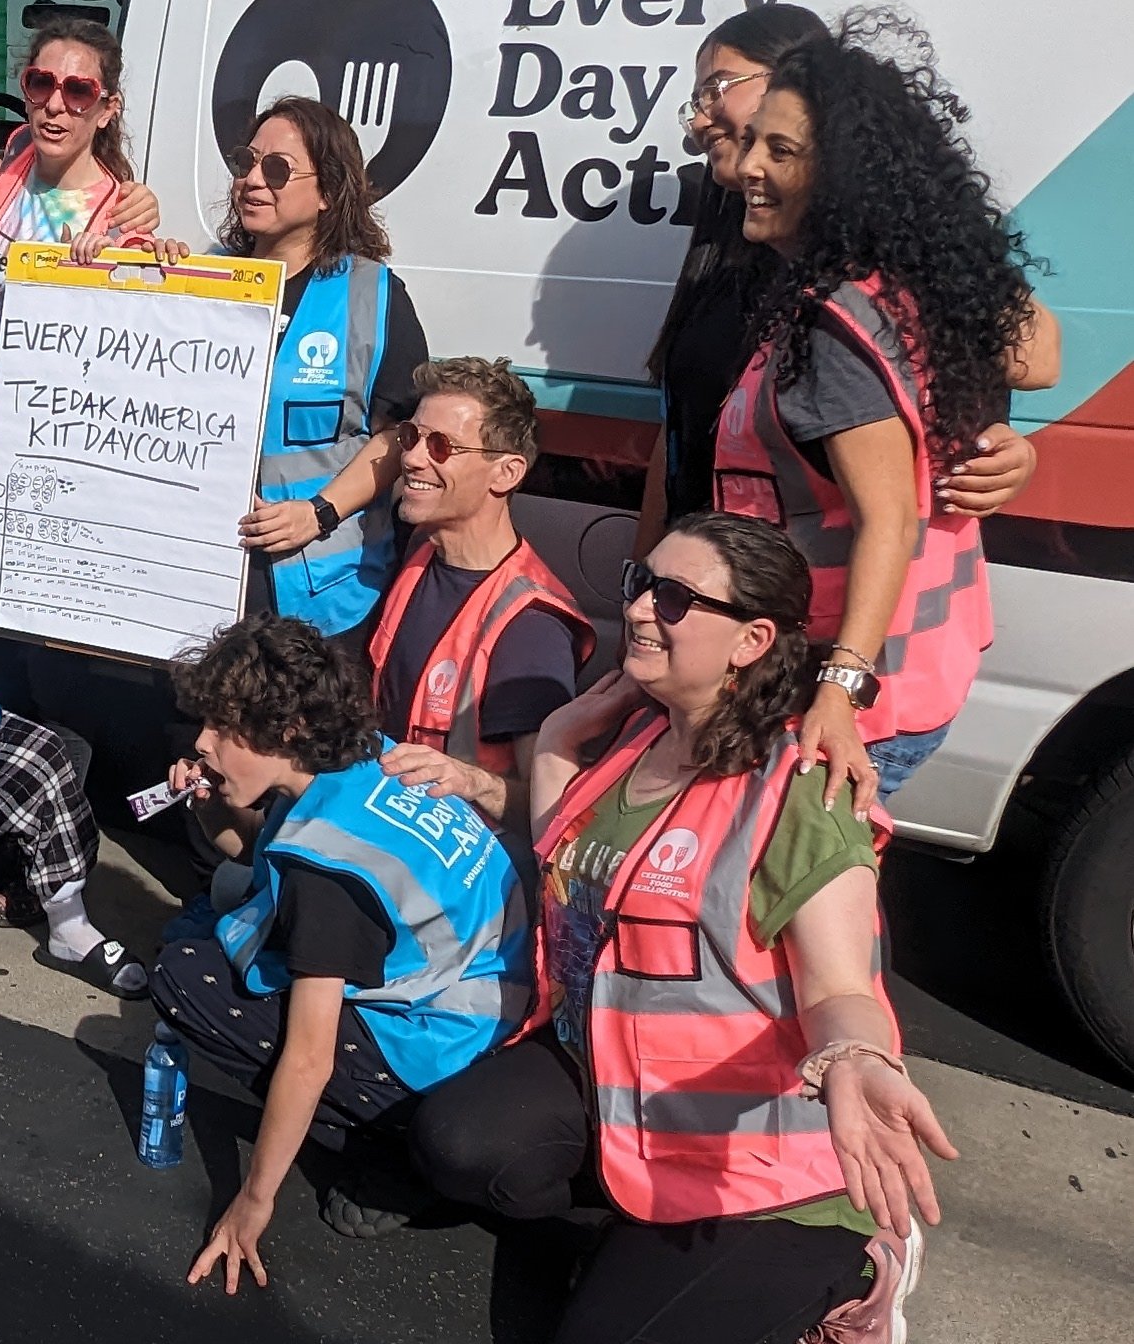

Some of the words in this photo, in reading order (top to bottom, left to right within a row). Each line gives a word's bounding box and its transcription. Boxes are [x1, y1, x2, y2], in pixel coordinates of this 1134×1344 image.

[488, 42, 677, 145] Day
[233, 269, 244, 282] 20
[2, 319, 88, 358] EVERY
[95, 327, 149, 370] DAY
[147, 338, 255, 380] ACTION
[4, 380, 118, 422] TZEDAK
[121, 397, 236, 442] AMERICA
[28, 417, 85, 448] KIT
[83, 423, 133, 461] DAY
[133, 432, 223, 471] COUNT
[415, 798, 462, 841] Day
